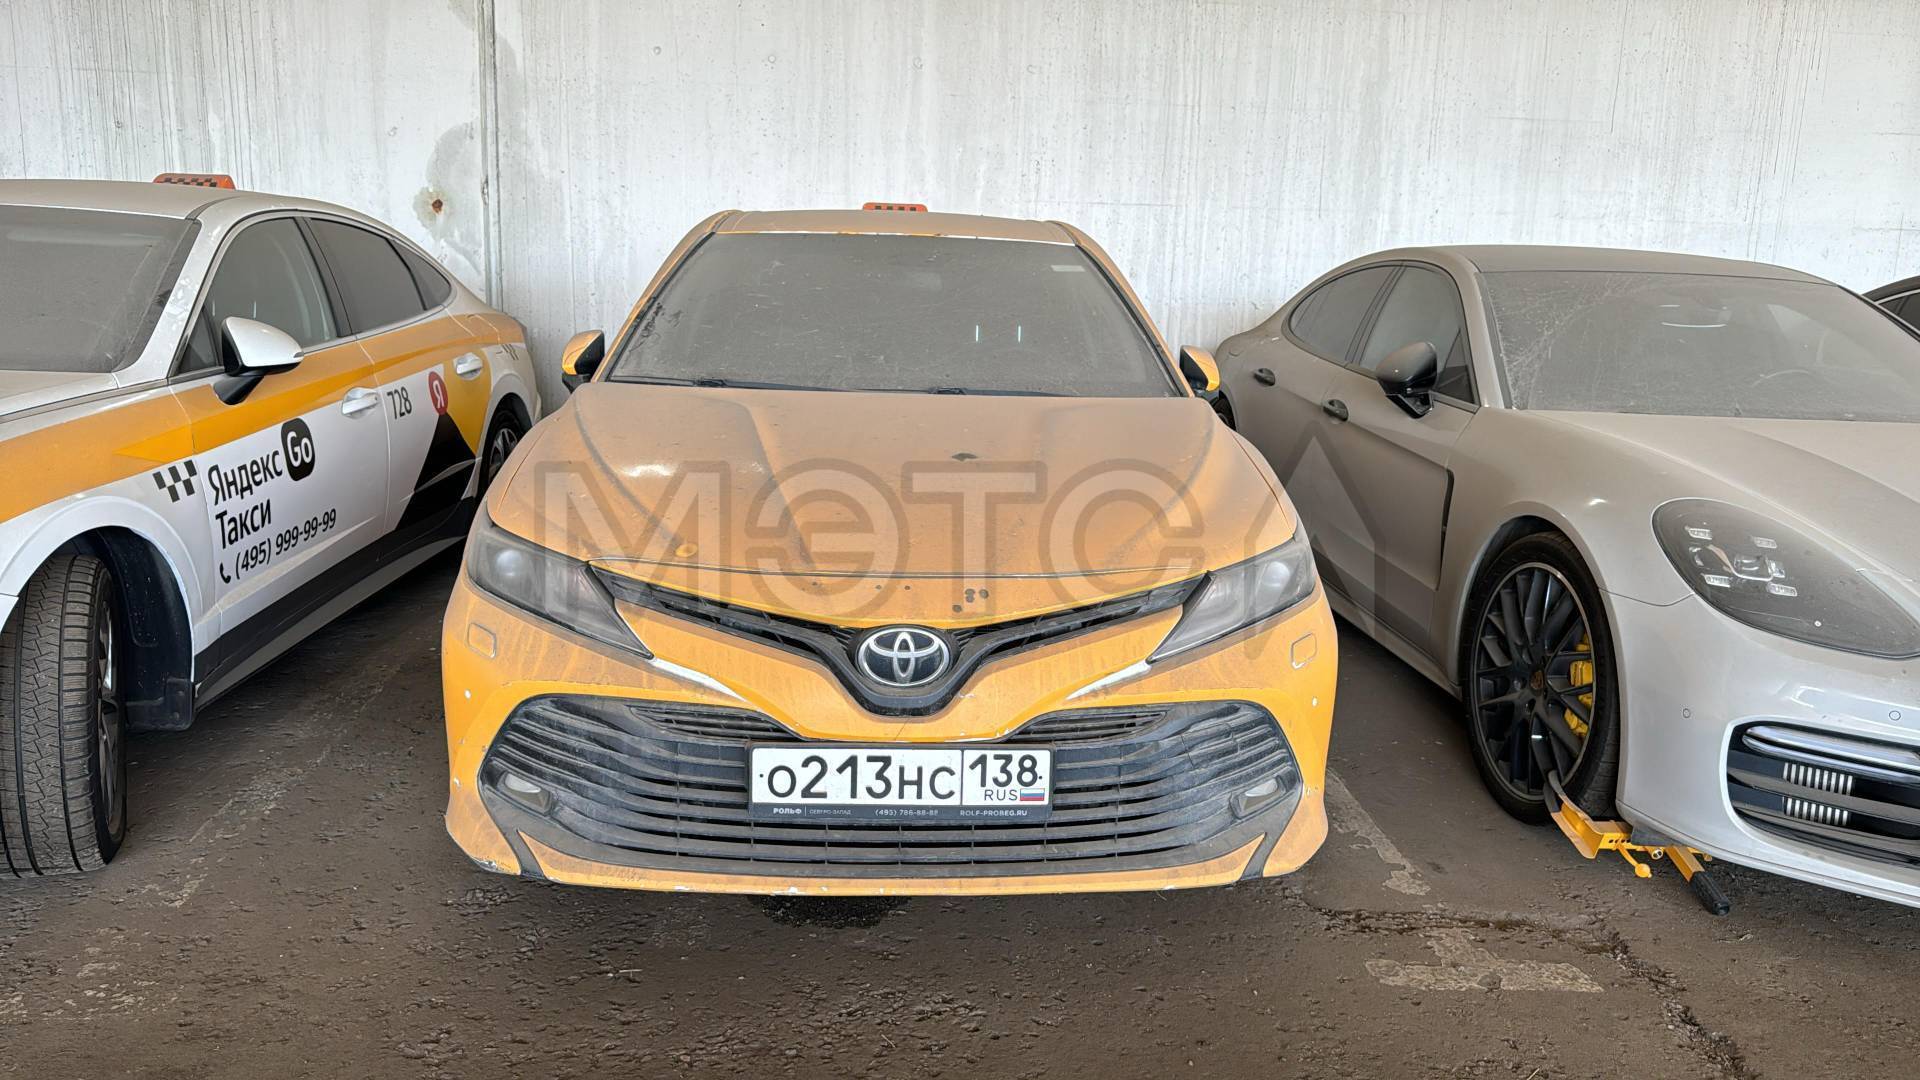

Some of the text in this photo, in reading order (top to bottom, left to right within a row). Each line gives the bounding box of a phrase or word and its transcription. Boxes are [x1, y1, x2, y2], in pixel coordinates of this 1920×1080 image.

[387, 387, 413, 420] 728
[207, 430, 312, 506] Яндекс Go
[215, 498, 272, 549] Такси
[235, 508, 337, 580] (495) 999-99-99
[968, 754, 1039, 788] 138
[773, 807, 802, 815] РОЛЬФ
[984, 789, 1018, 802] RUS
[960, 809, 1028, 817] ROLF-PROBEG.RU
